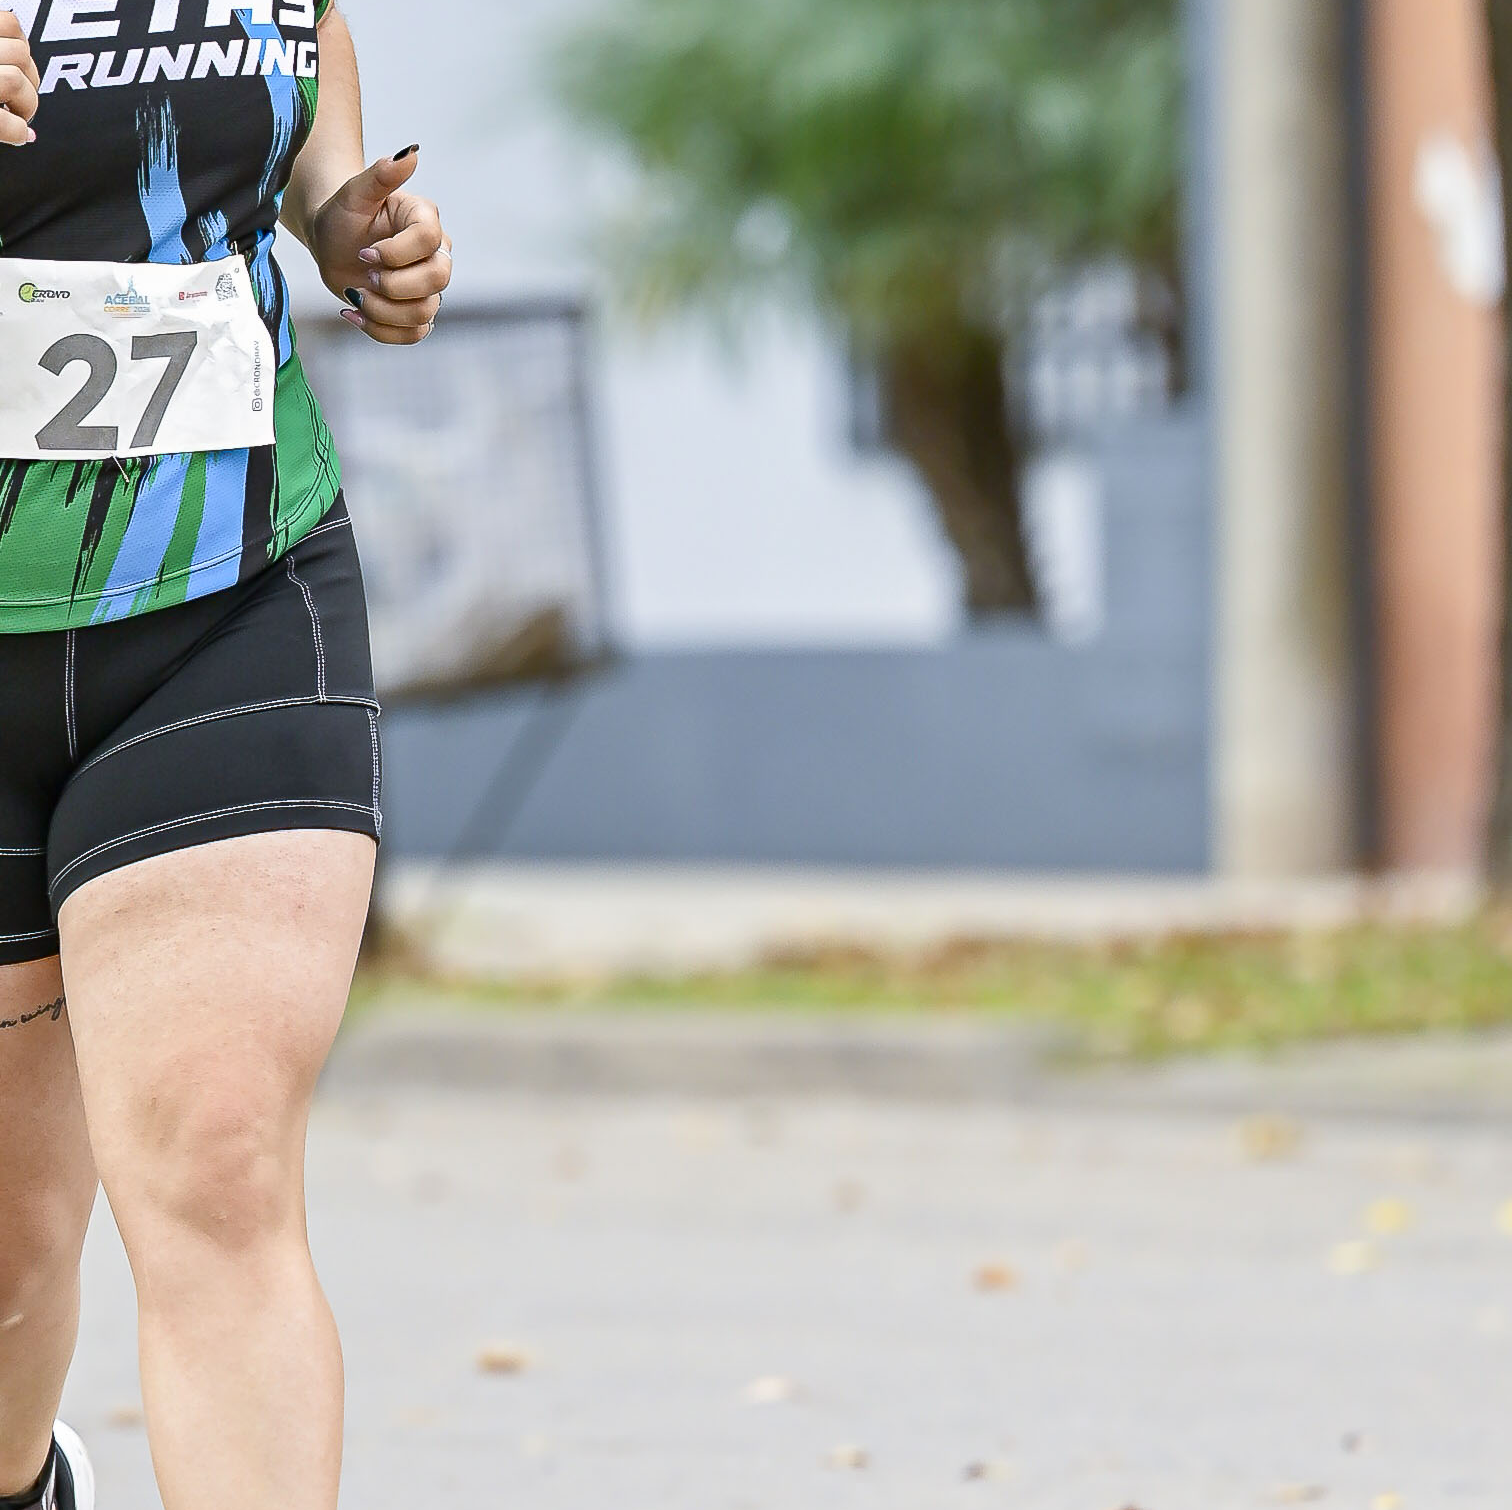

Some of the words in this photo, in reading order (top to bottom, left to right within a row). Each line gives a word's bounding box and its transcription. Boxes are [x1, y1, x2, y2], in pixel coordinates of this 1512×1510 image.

[38, 38, 319, 94] RUNNING
[104, 295, 151, 305] ACEBAL
[35, 331, 197, 450] 27
